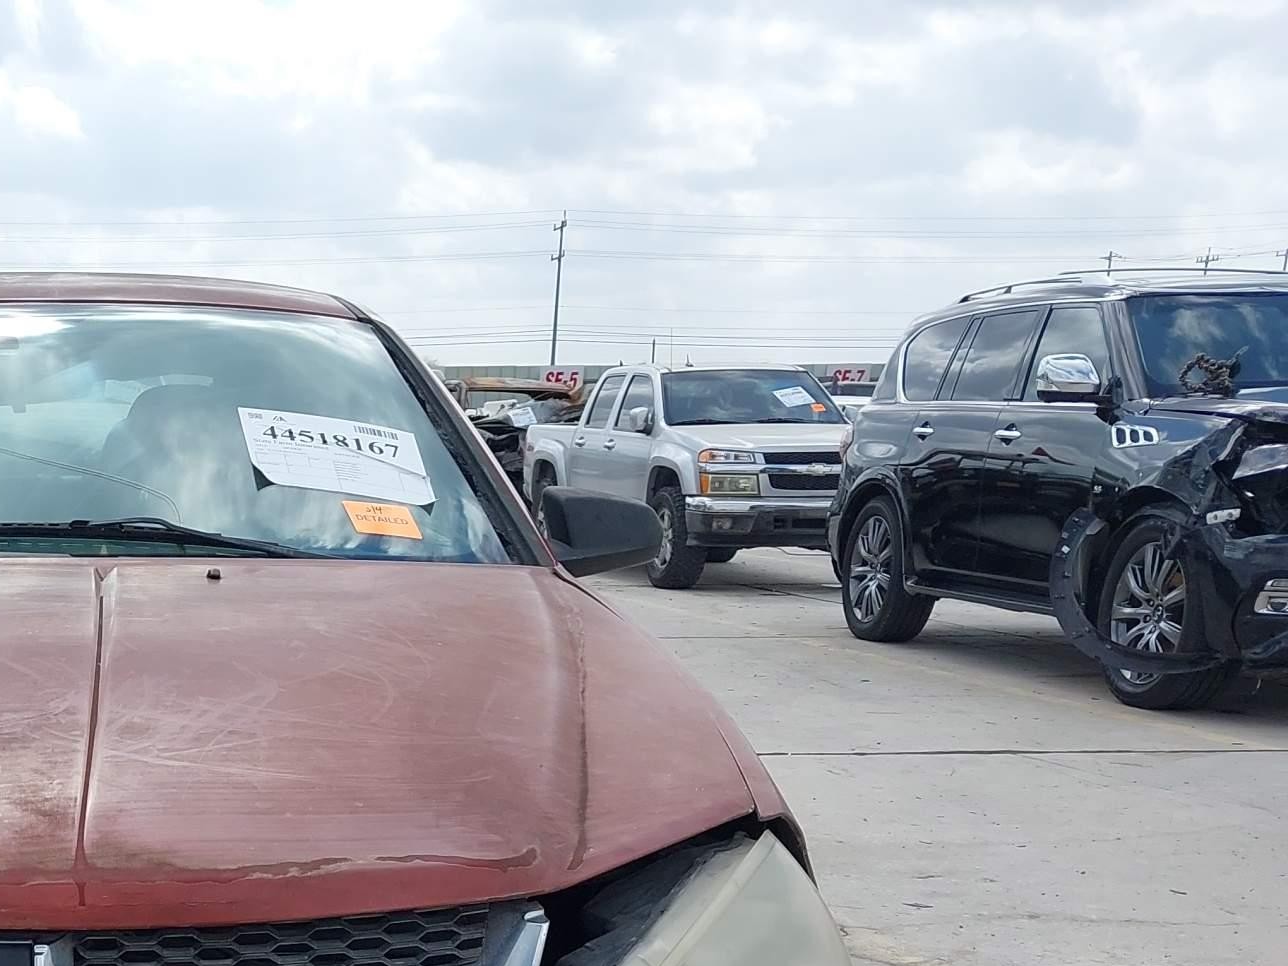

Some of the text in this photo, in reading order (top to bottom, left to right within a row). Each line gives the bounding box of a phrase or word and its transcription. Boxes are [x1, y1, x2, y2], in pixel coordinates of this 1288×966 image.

[545, 371, 579, 389] SE-5
[262, 425, 399, 458] 44518167
[355, 514, 409, 525] DETAILED
